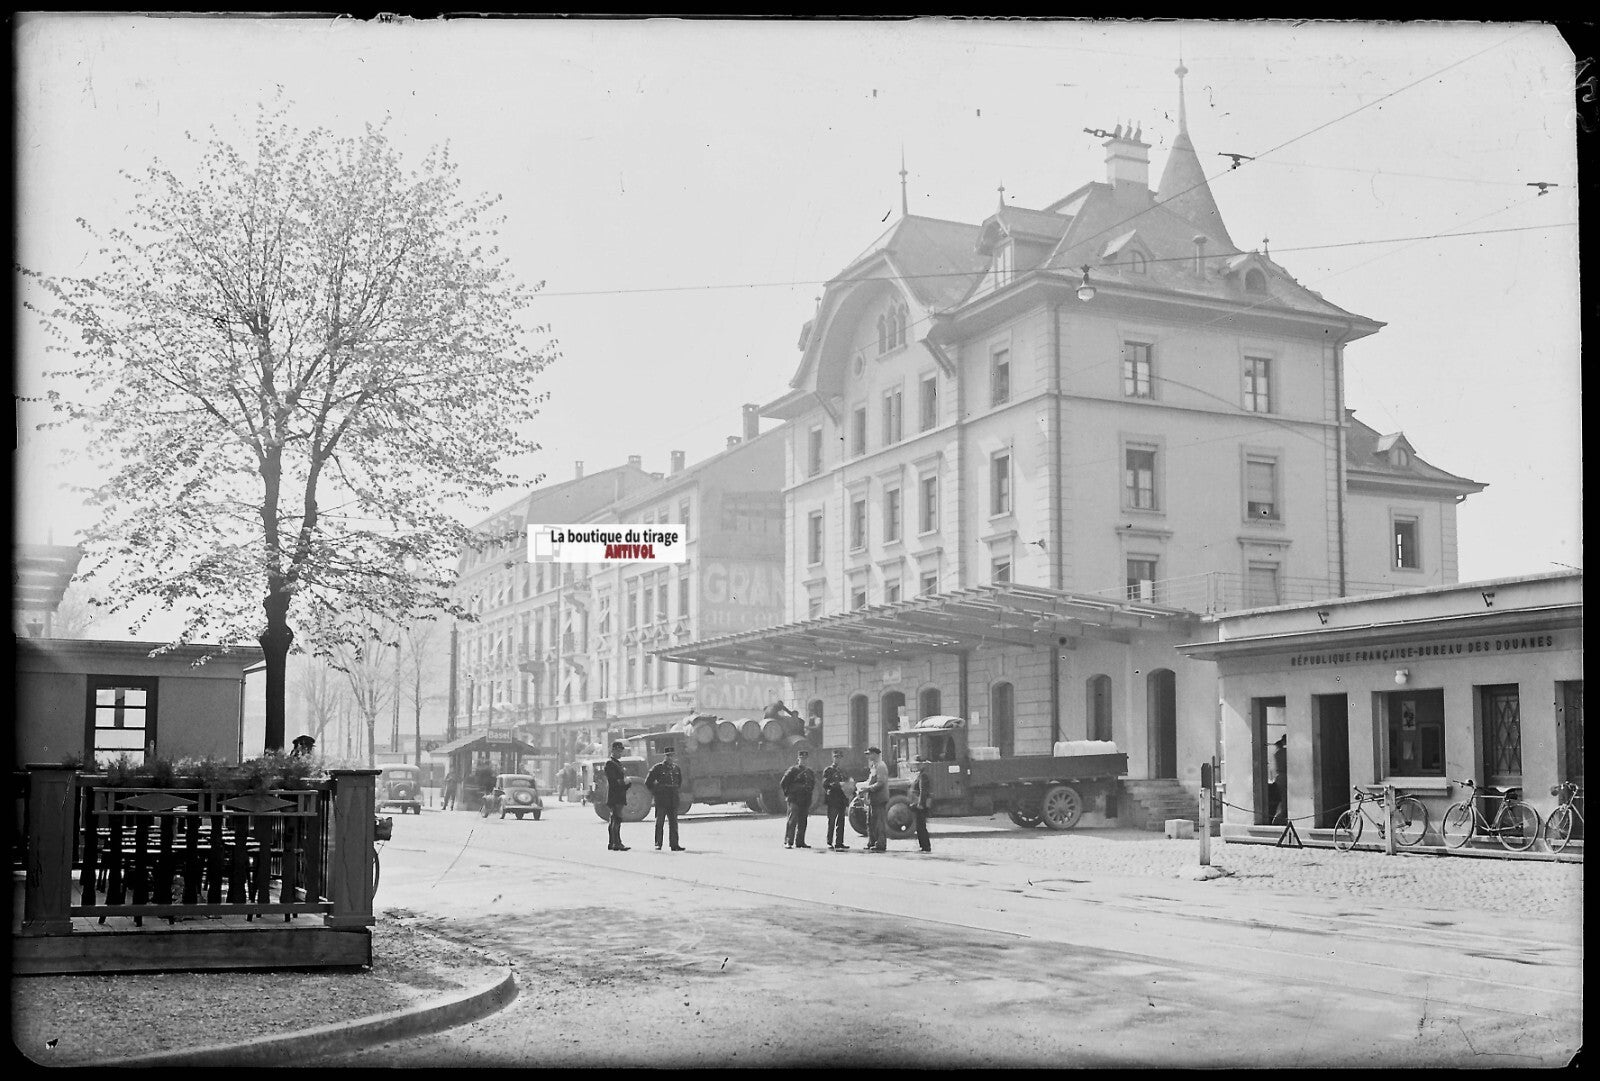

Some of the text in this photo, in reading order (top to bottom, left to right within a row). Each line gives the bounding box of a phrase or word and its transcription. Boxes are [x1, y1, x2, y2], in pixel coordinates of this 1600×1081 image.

[1291, 652, 1351, 666] RÉPUBLIQUE
[1468, 641, 1489, 653] DES
[1496, 635, 1553, 651] DOUANES
